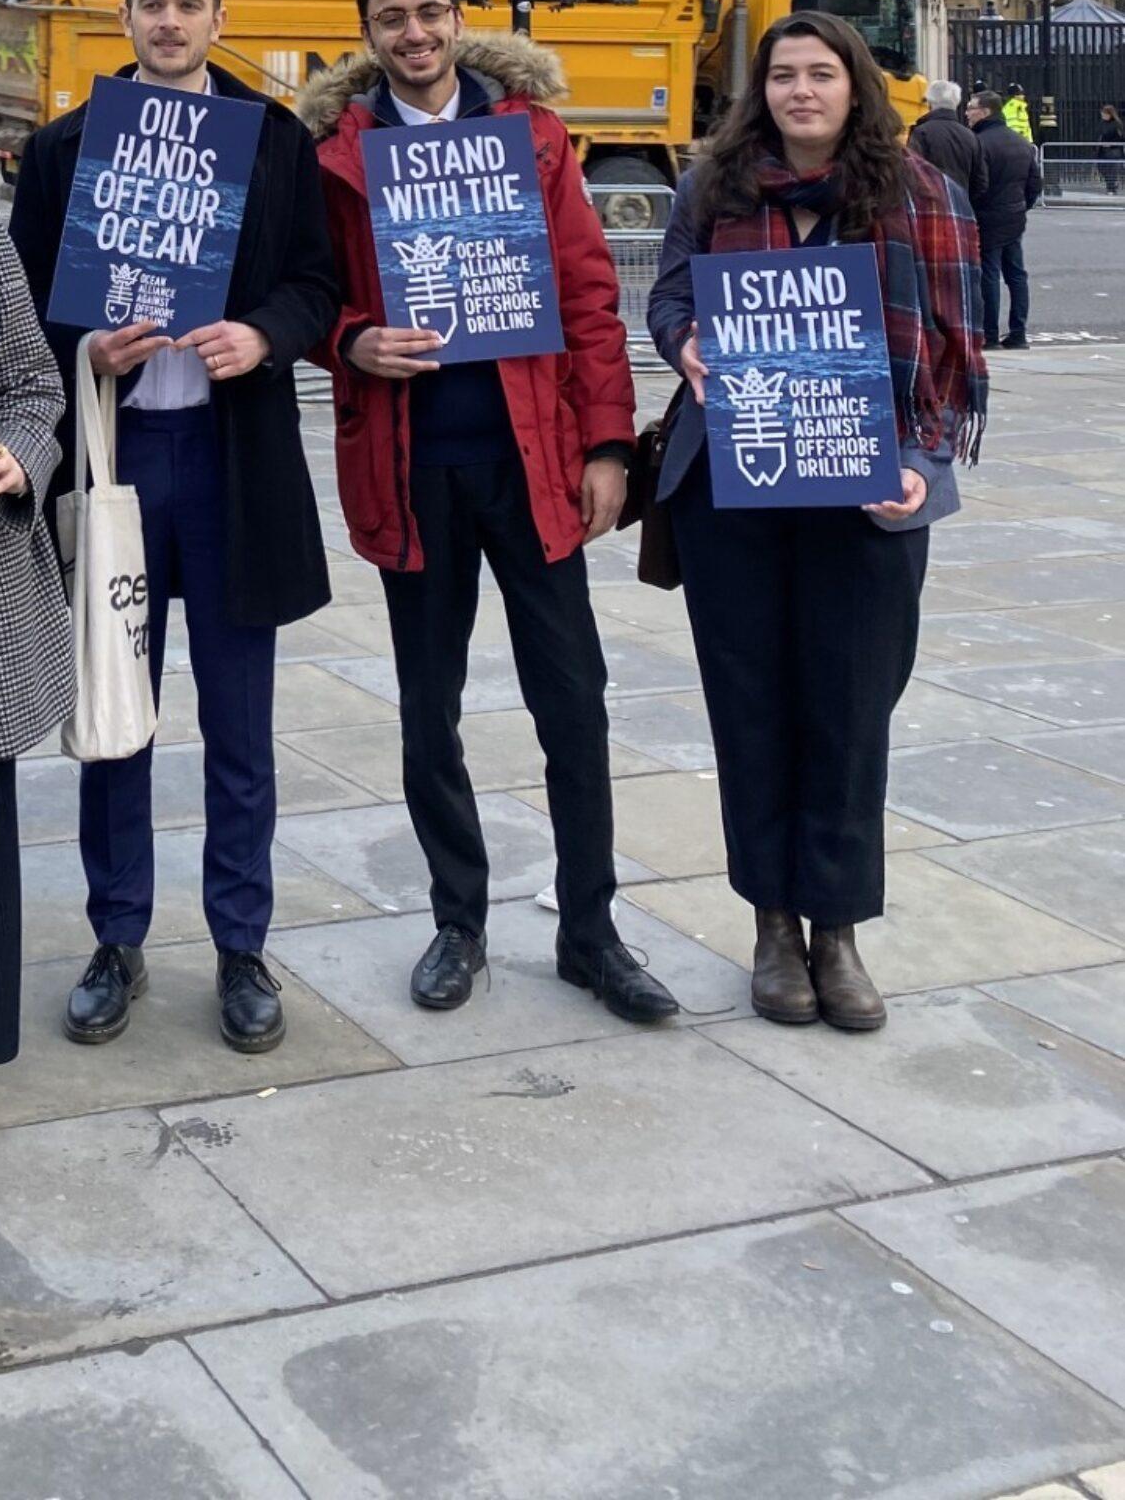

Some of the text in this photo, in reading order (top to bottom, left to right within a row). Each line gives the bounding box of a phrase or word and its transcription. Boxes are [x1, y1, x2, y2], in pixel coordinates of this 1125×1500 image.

[139, 97, 208, 144] OILY
[112, 133, 217, 187] HANDS
[390, 135, 506, 181] I STAND
[93, 170, 220, 228] OFF OUR
[382, 173, 524, 223] WITH THE
[96, 211, 205, 265] OCEAN
[456, 238, 506, 259] OCEAN
[458, 255, 530, 279] ALLIANCE
[140, 272, 167, 286] OCEAN
[461, 274, 524, 297] AGAINST
[722, 266, 847, 311] I STAND
[136, 293, 170, 307] AGAINST
[138, 284, 176, 299] ALLIANCE
[134, 303, 175, 320] OFFSHORE
[464, 291, 542, 316] OFFSHORE
[466, 312, 535, 334] DRILLING
[712, 309, 866, 355] WITH THE
[789, 378, 843, 398] OCEAN
[791, 397, 870, 417] ALLIANCE
[793, 416, 861, 438] AGAINST
[795, 437, 880, 457] OFFSHORE
[796, 457, 871, 478] DRILLING
